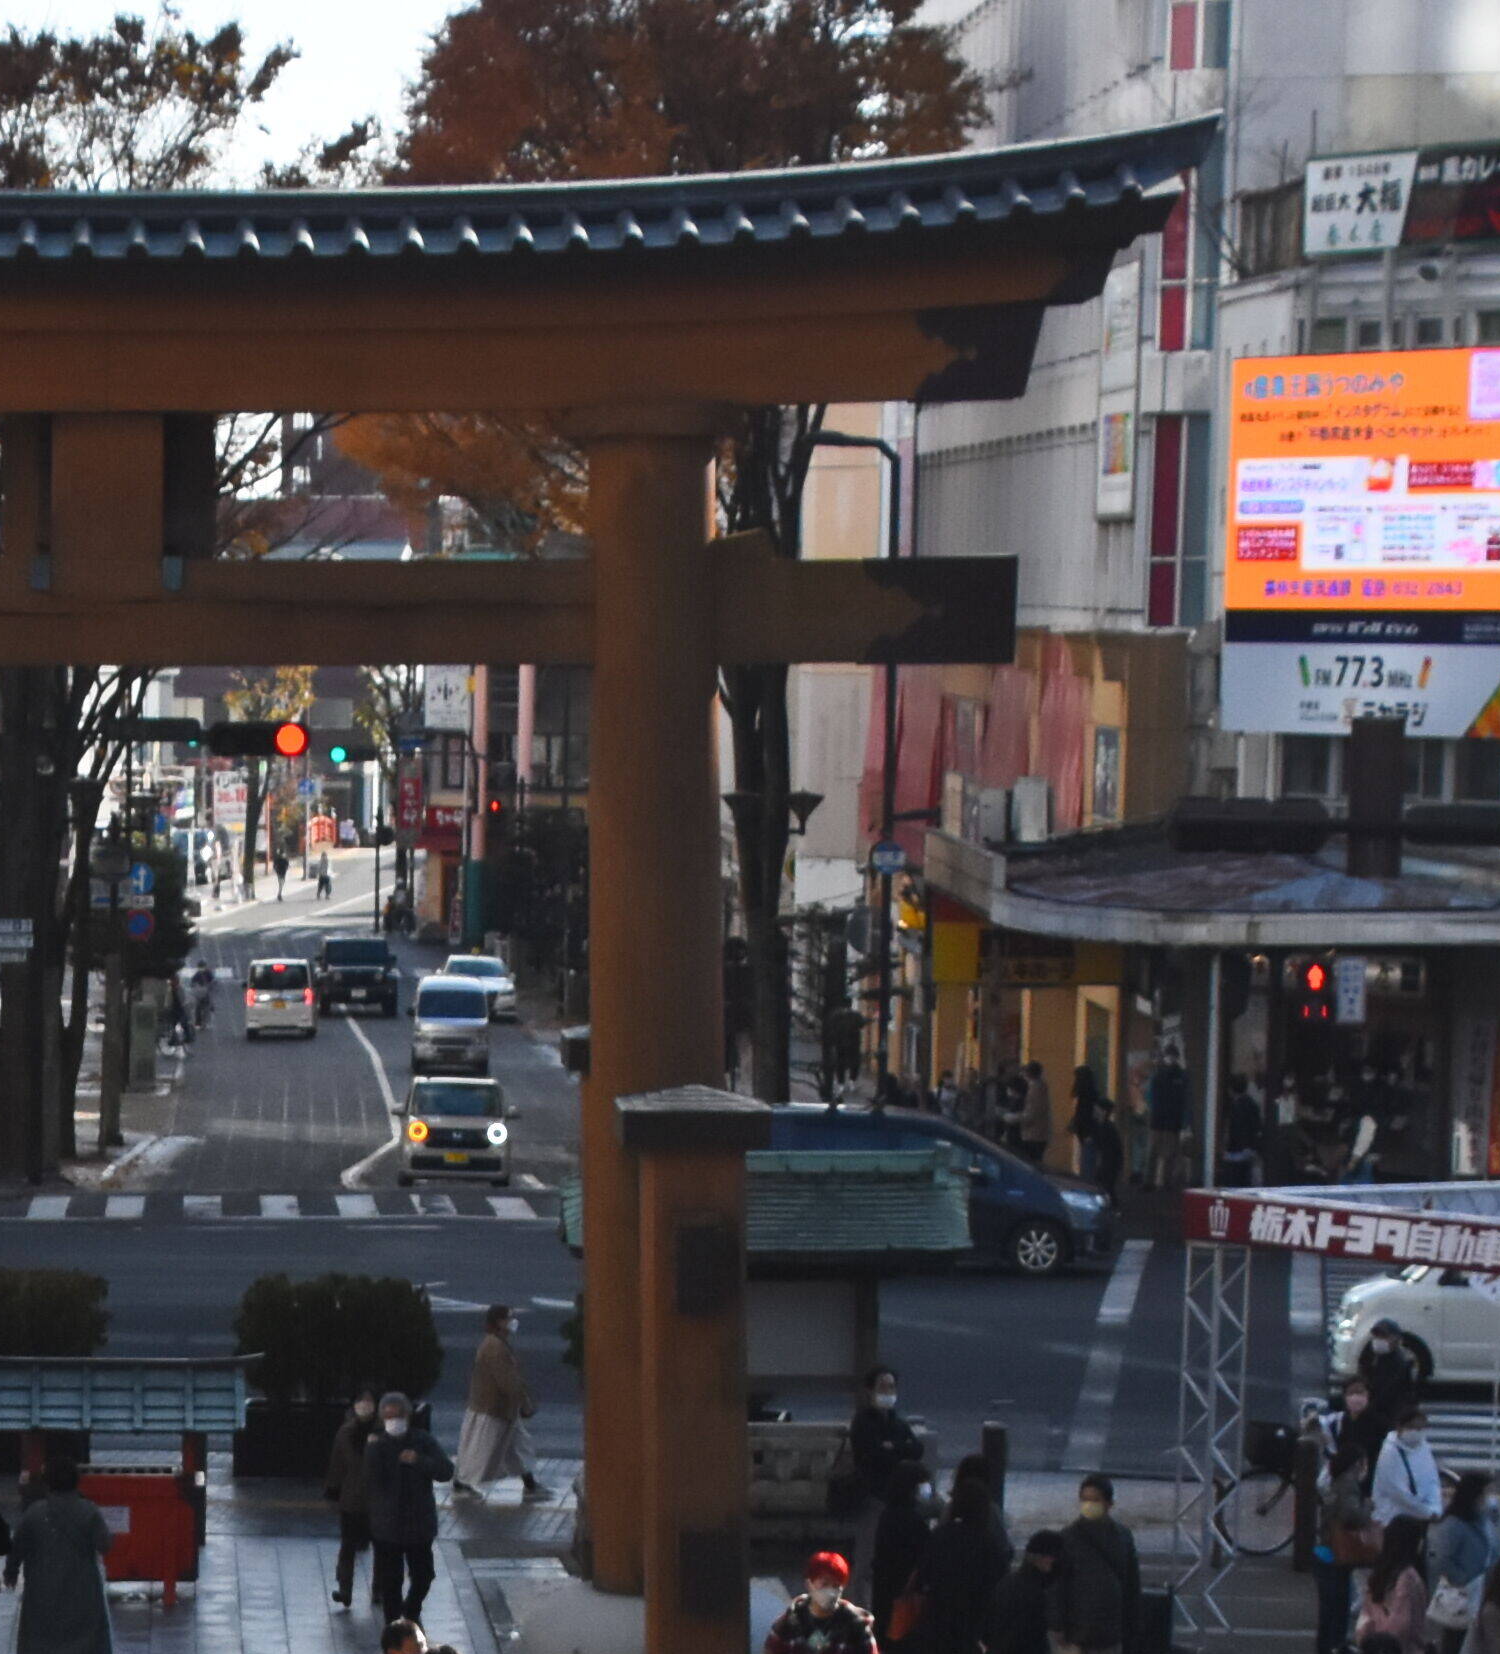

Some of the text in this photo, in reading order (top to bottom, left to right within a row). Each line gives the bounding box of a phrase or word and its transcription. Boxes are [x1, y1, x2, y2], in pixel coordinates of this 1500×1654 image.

[1315, 655, 1412, 688] FM 77.3 MHz
